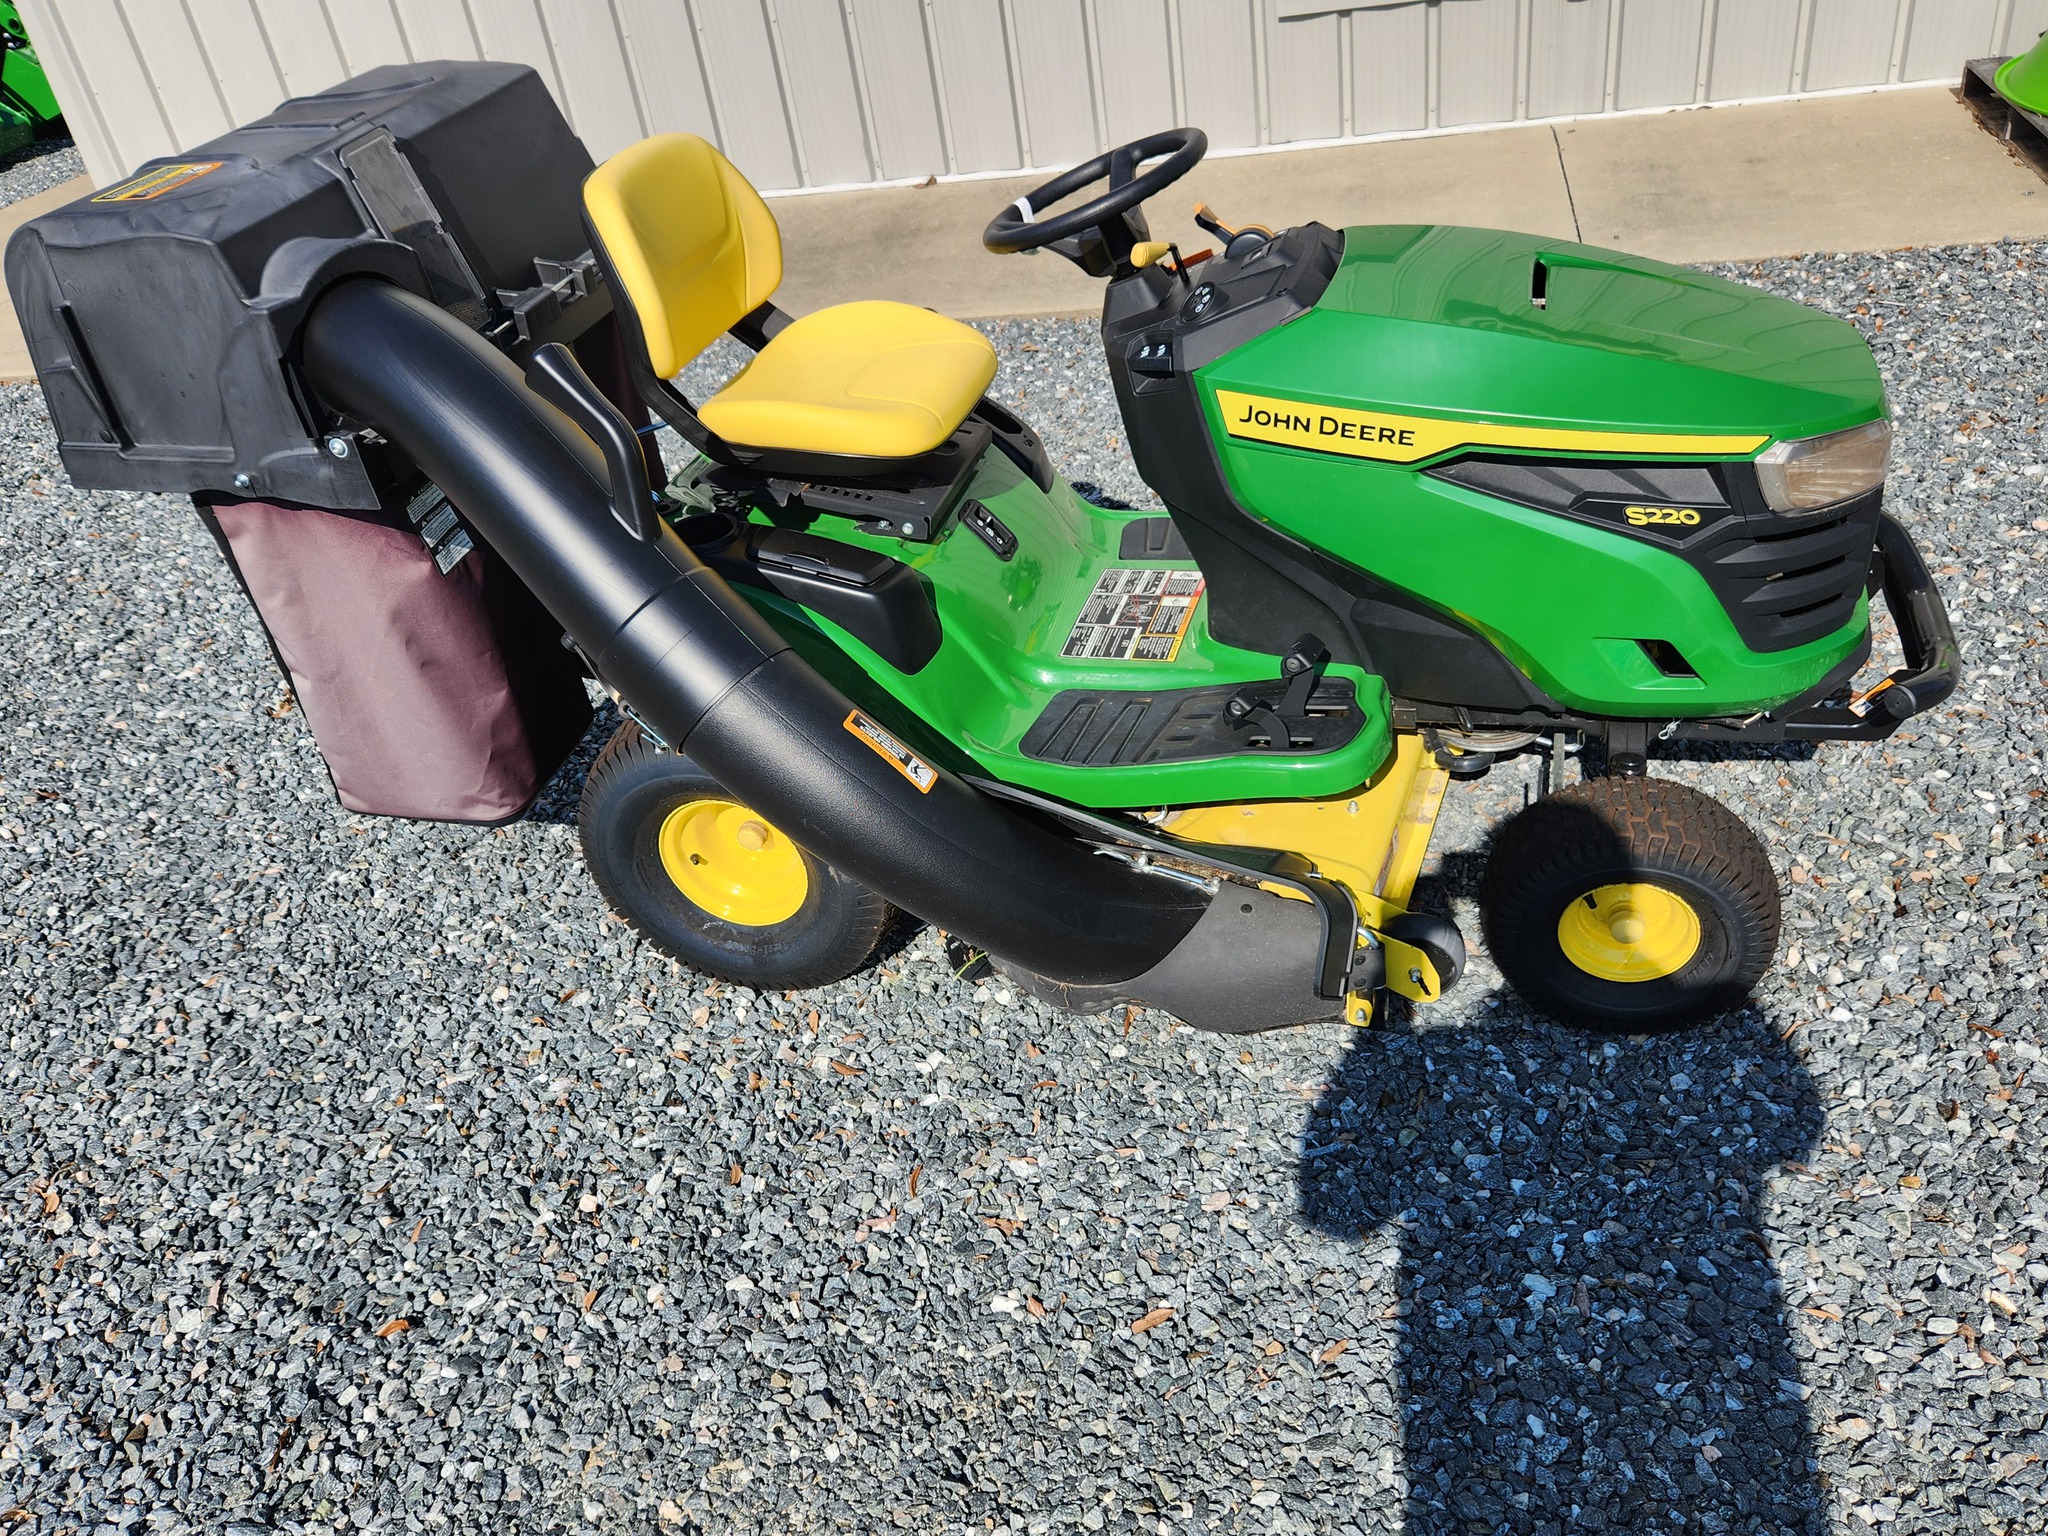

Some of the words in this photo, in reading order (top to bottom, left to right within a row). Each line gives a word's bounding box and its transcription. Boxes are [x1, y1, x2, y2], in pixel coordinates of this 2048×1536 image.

[1239, 405, 1311, 433] JOHN
[1319, 416, 1416, 447] DEERE
[1625, 506, 1701, 526] S220
